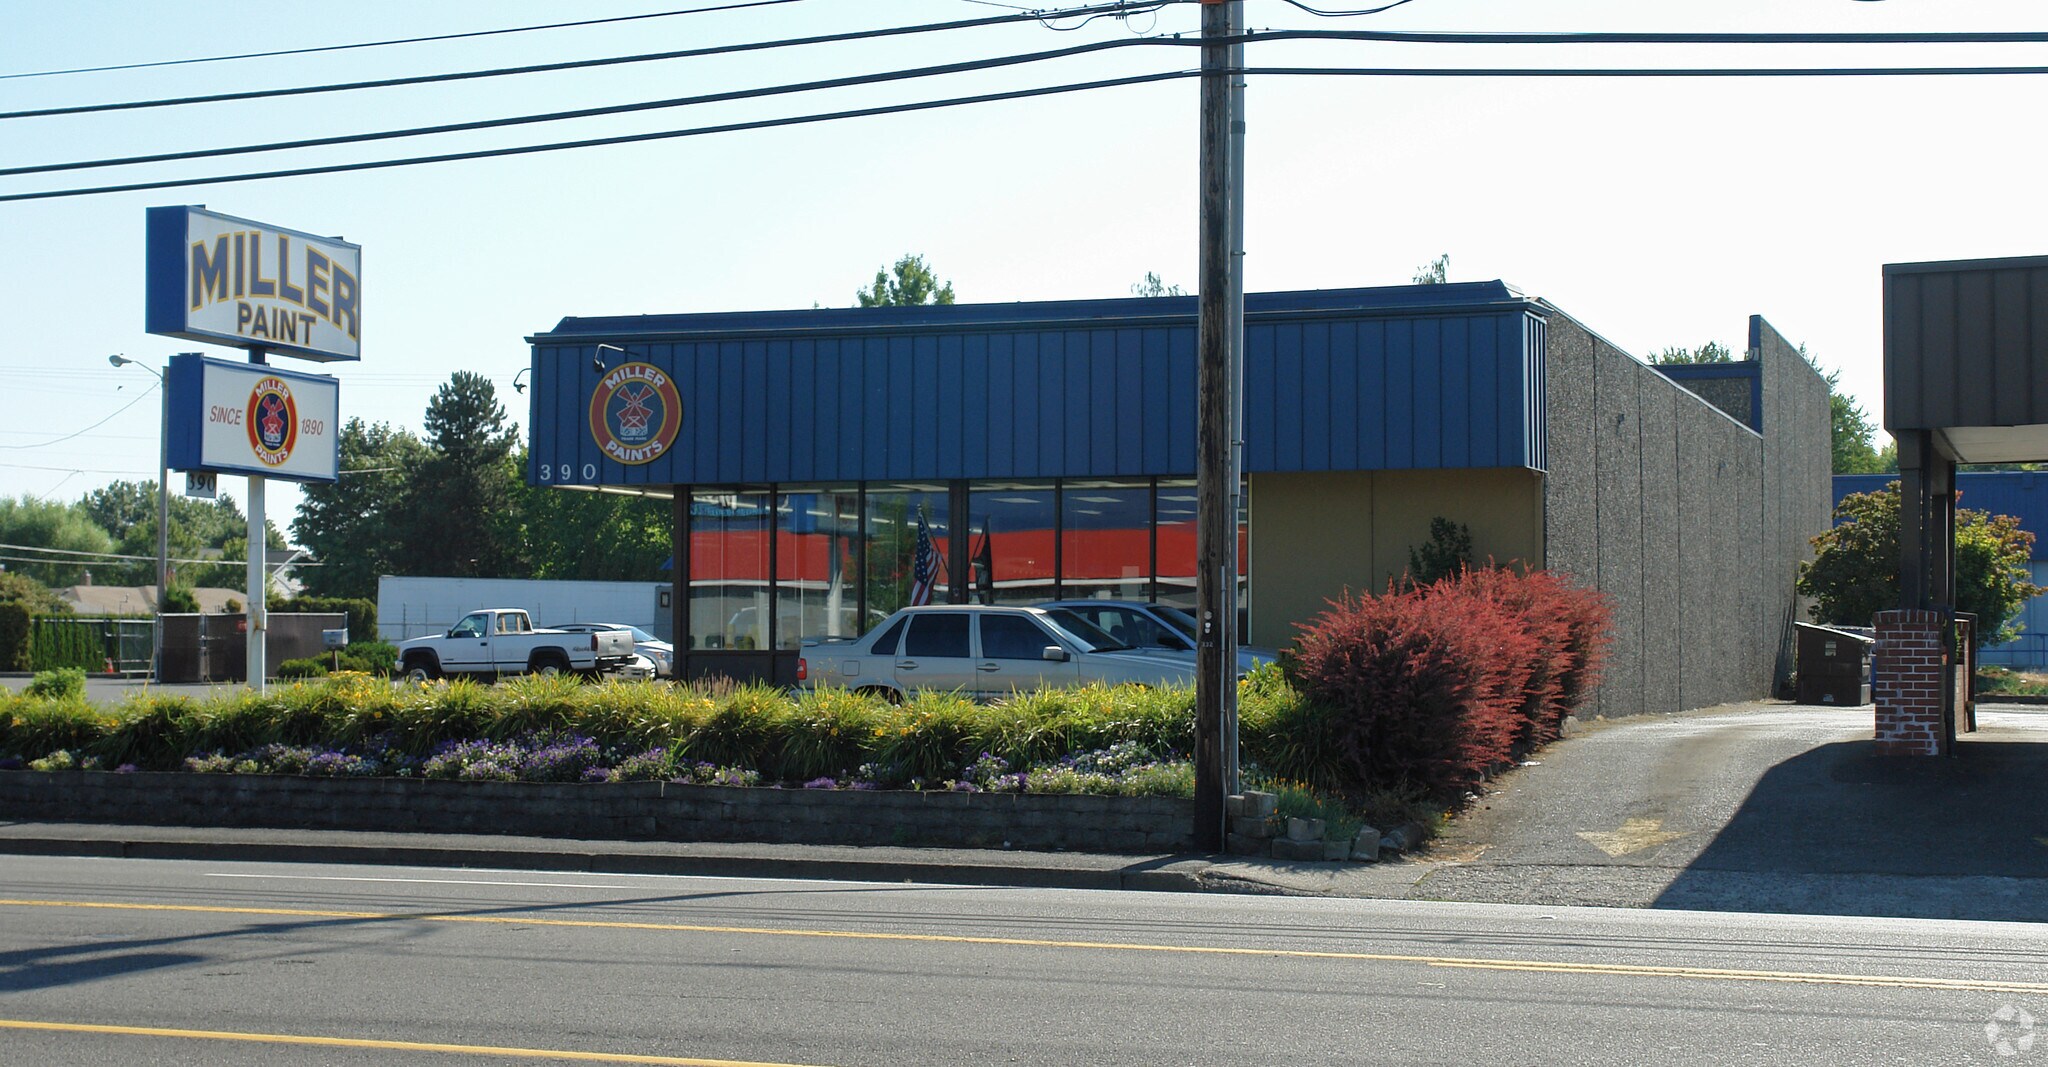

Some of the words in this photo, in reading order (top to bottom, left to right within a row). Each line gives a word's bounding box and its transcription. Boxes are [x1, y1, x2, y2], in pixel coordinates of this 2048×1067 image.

[191, 231, 357, 341] MILLER
[237, 302, 317, 347] PAINT
[604, 366, 666, 390] MILLER
[255, 379, 290, 400] MILLER
[209, 405, 242, 426] SINCE
[301, 419, 324, 436] 1890
[254, 443, 289, 465] PAINTS
[605, 440, 663, 461] PAINTS
[187, 474, 215, 492] 390
[540, 464, 596, 481] 390
